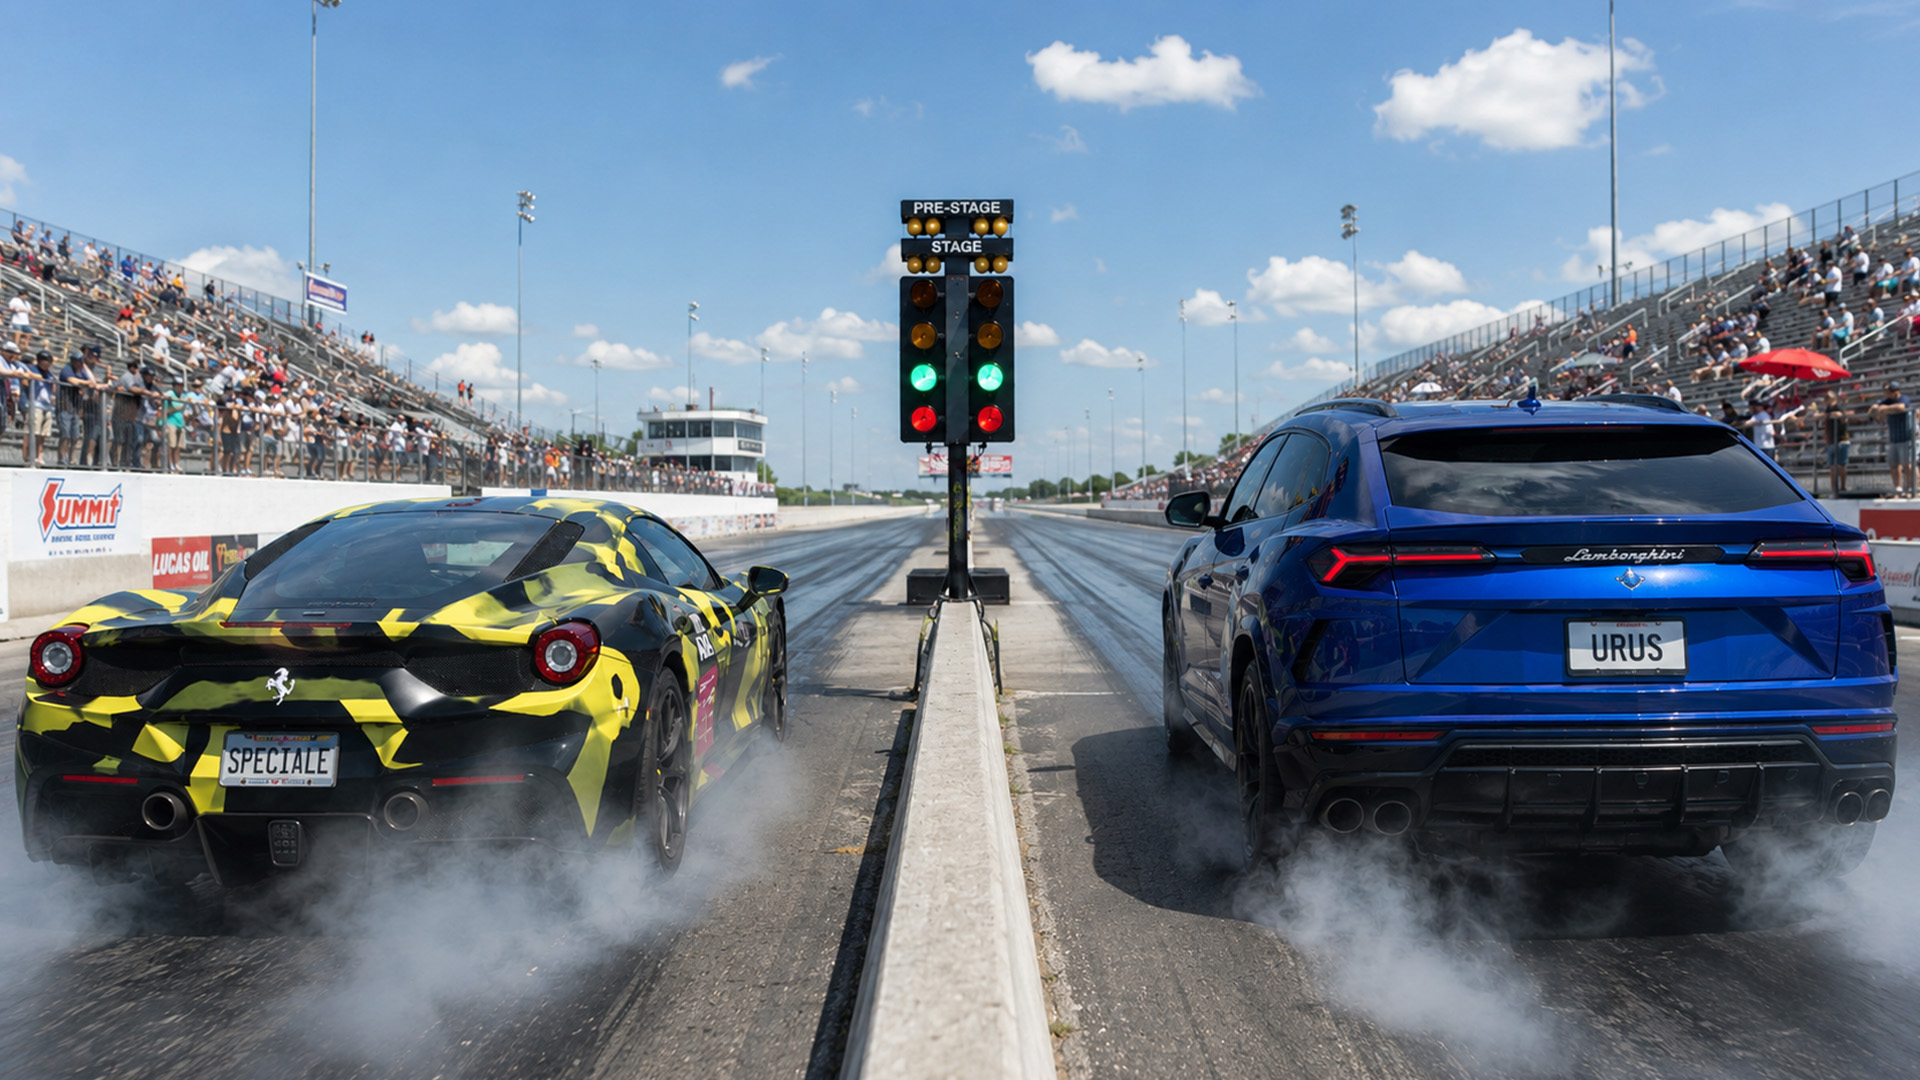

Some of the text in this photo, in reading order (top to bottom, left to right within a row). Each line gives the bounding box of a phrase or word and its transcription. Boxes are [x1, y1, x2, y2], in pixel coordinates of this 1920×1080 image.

[913, 201, 1001, 215] PRE-STAGE
[931, 240, 982, 253] STAGE
[40, 480, 121, 536] SUMMIT
[153, 551, 191, 576] LUCAS
[192, 550, 210, 573] OIL
[1563, 548, 1685, 564] Lamborghini
[1592, 633, 1664, 662] URUS
[227, 746, 331, 775] SPECIALE
